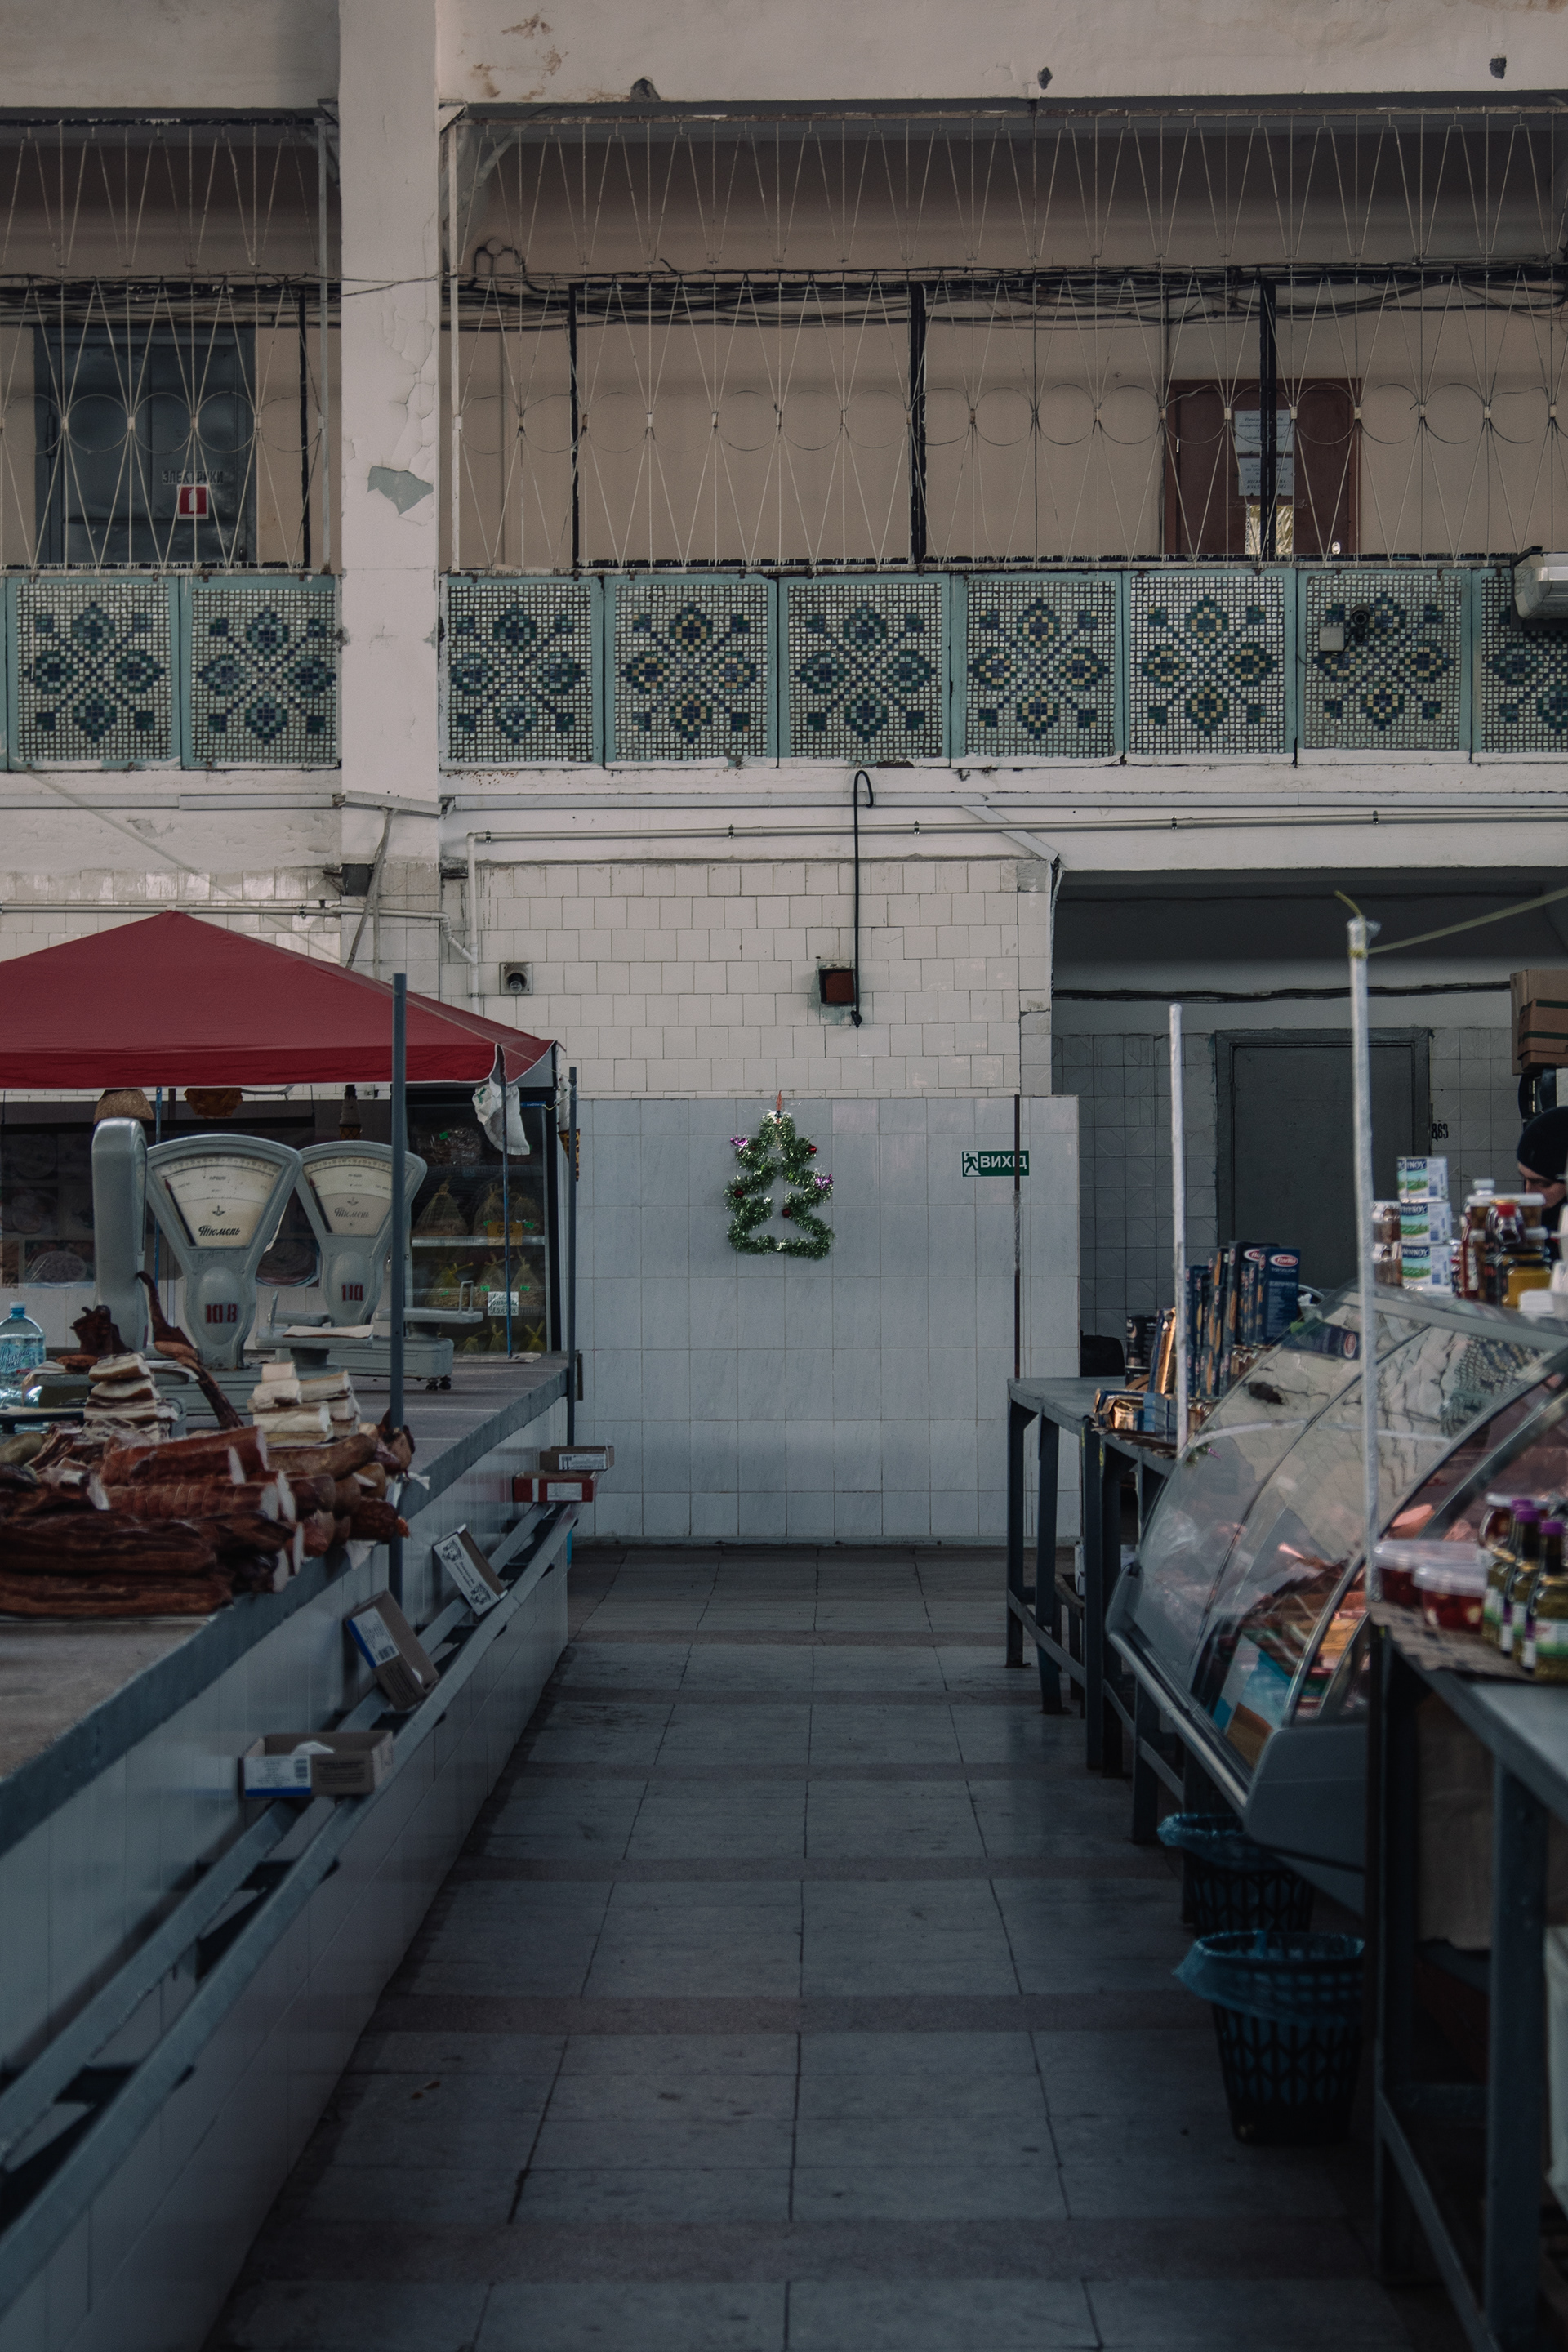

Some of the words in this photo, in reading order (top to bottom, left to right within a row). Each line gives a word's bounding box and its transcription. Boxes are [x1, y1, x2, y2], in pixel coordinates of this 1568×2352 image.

[163, 470, 223, 483] ЭЛЕКТРИКИ
[1432, 1123, 1449, 1140] 863
[980, 1155, 1027, 1169] ВИХІД
[334, 1207, 370, 1218] Тюмень
[198, 1225, 241, 1236] Тюмень
